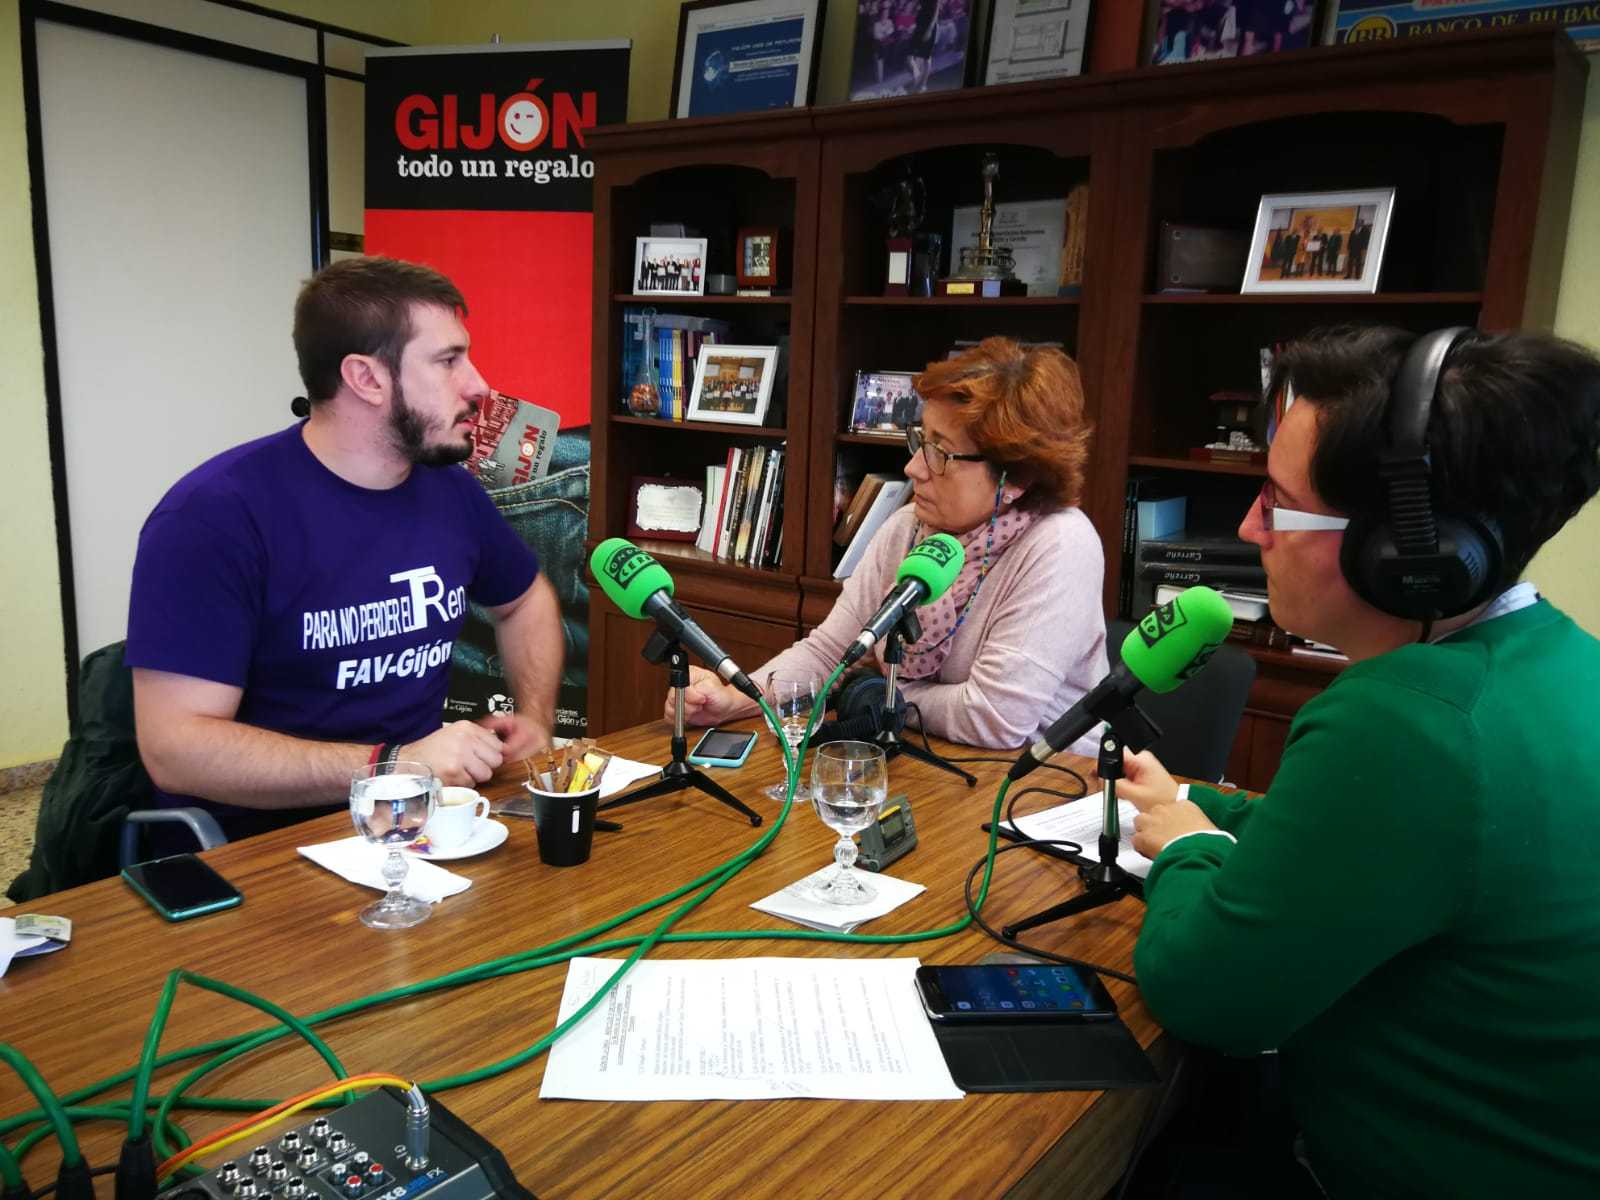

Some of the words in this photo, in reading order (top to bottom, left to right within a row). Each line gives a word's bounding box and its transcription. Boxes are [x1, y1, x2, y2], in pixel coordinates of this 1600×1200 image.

[395, 78, 598, 152] GIJÓN
[397, 154, 453, 178] todo
[460, 159, 498, 178] un
[504, 154, 595, 184] regalo
[303, 609, 341, 650] PARA
[339, 605, 360, 647] NO
[359, 597, 402, 642] PERDER
[336, 639, 453, 690] FAV-Gijón
[426, 1167, 445, 1179] FX
